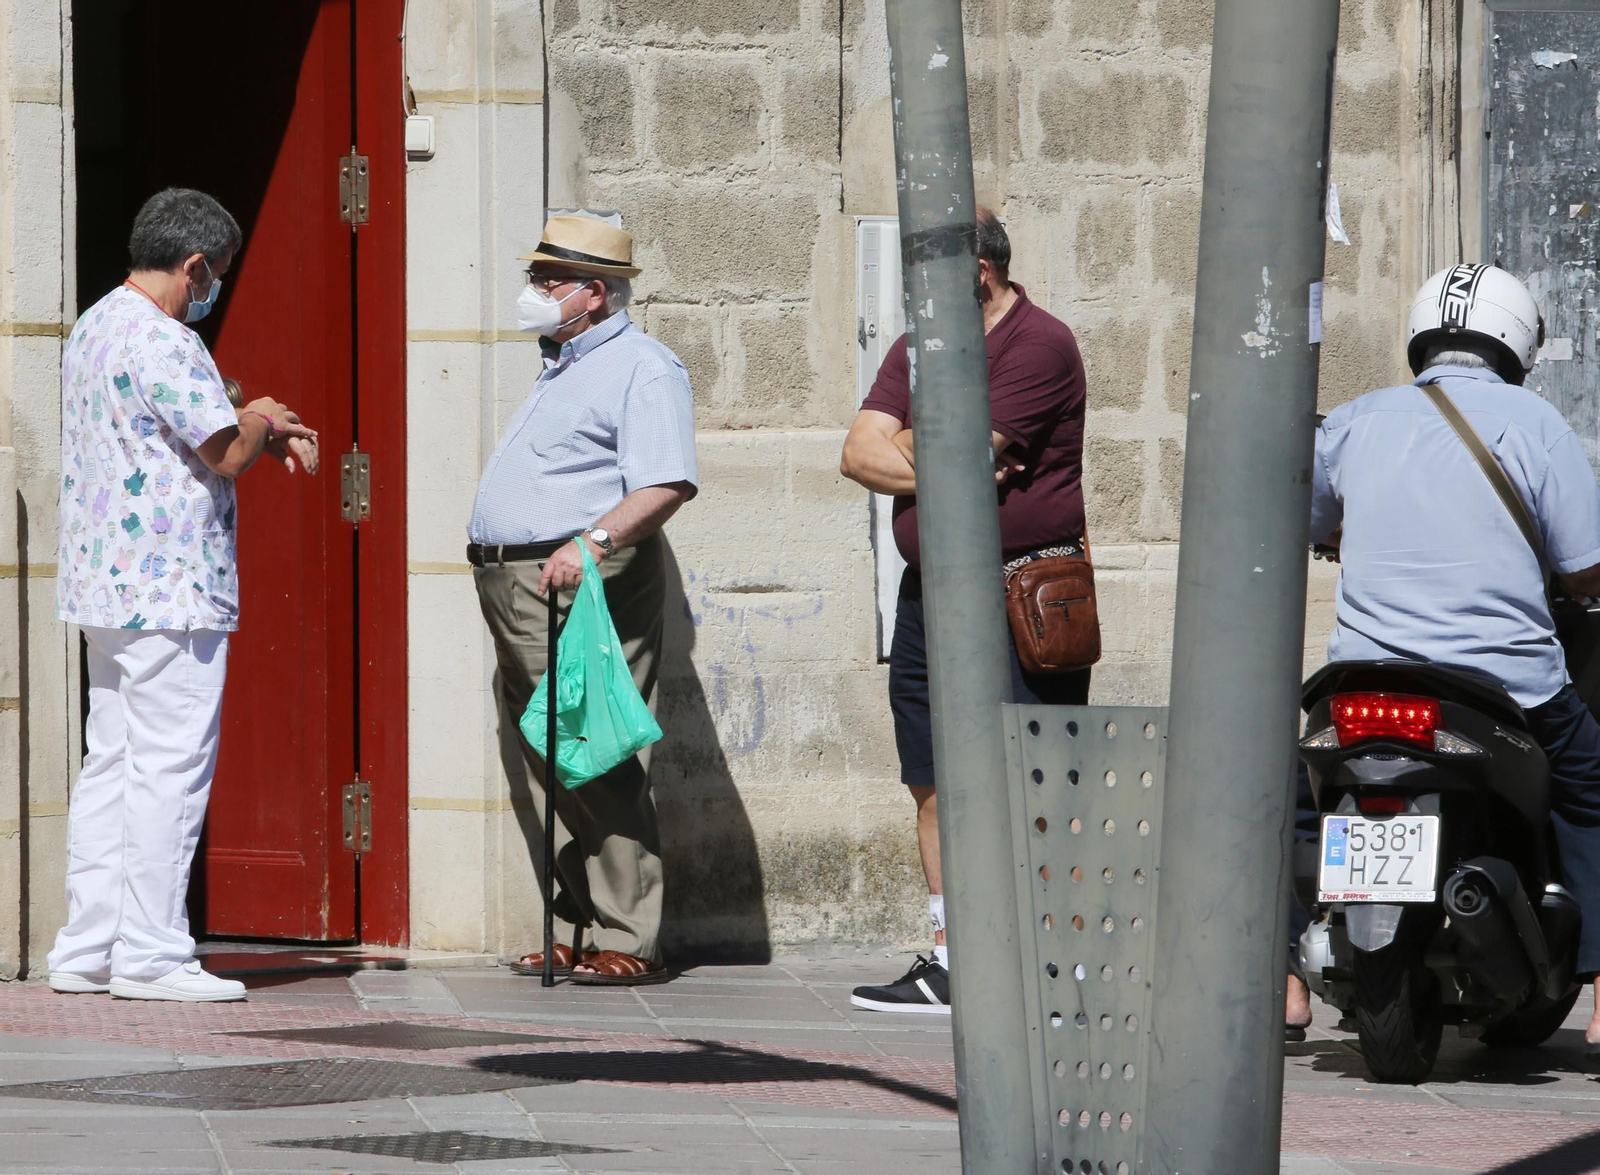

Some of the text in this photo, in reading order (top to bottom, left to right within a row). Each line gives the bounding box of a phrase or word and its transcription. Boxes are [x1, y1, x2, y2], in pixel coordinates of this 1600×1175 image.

[1330, 846, 1341, 857] E
[1349, 823, 1424, 852] 5381
[1349, 855, 1415, 885] HZZ
